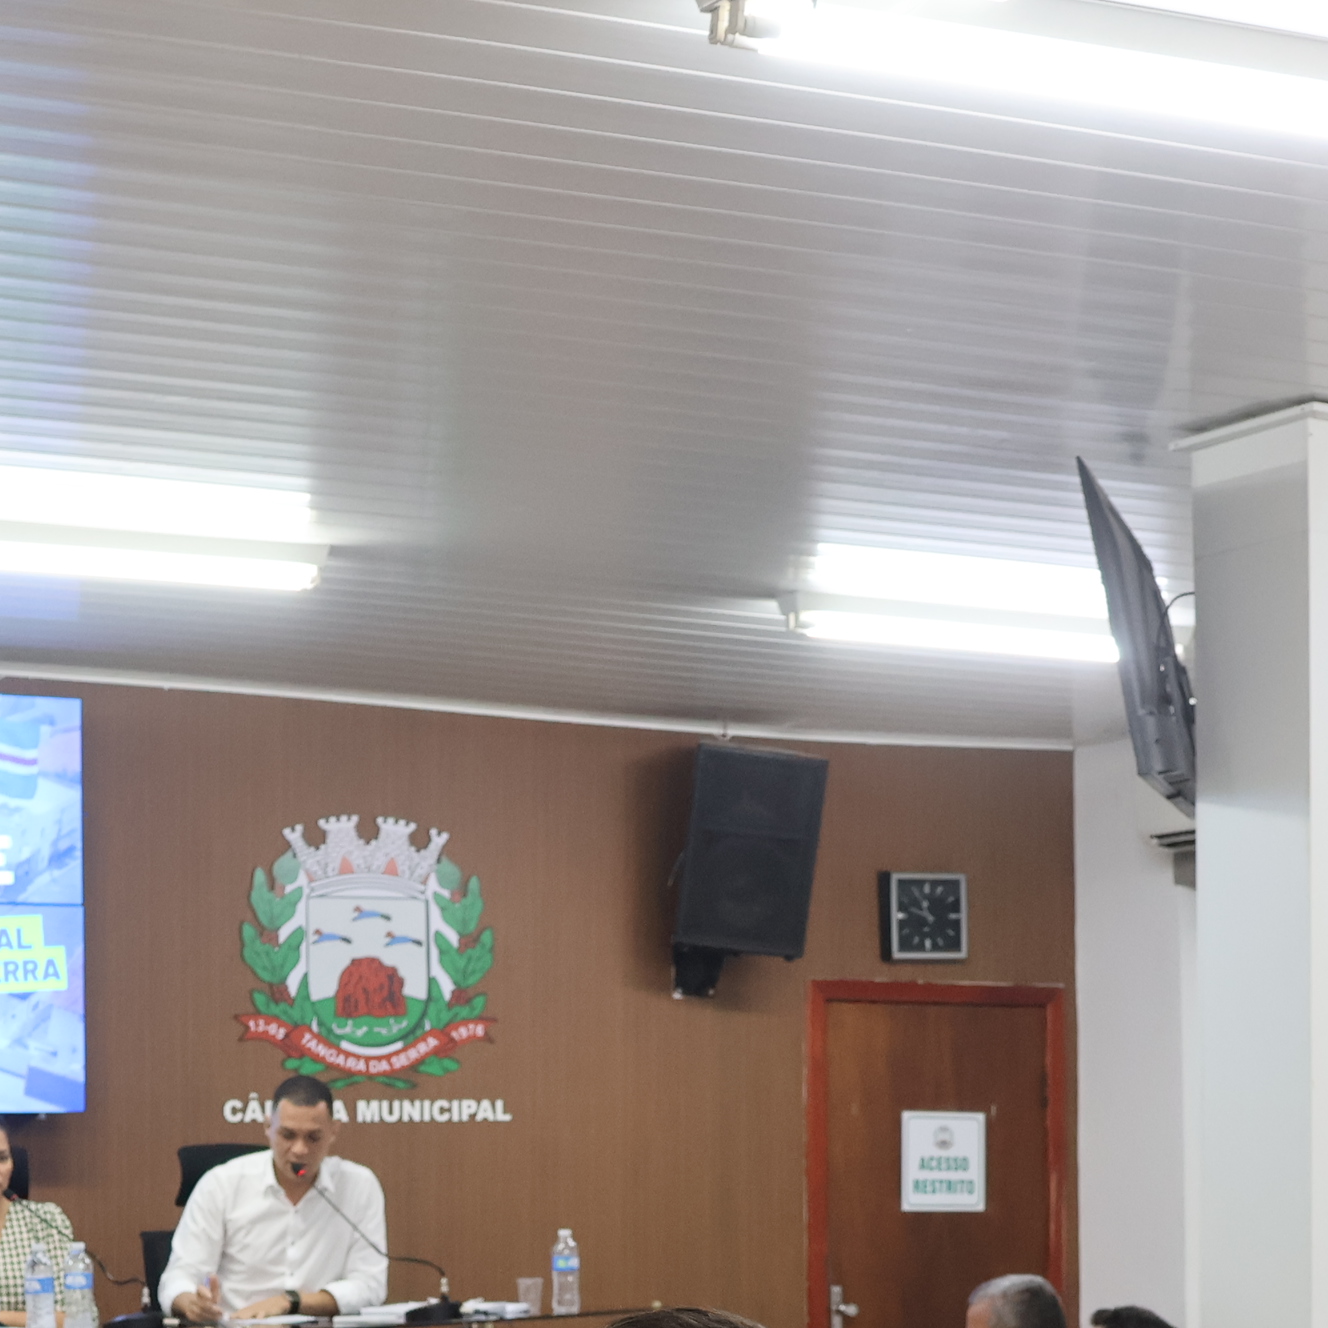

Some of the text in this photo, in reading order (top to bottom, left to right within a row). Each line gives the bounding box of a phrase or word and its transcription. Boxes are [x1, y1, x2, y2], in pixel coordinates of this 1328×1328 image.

[300, 1032, 440, 1074] TANGARÁ DA SERRA
[356, 1099, 513, 1123] MUNICIPAL
[918, 1156, 970, 1172] ACESSO
[913, 1178, 976, 1195] RESTRITO
